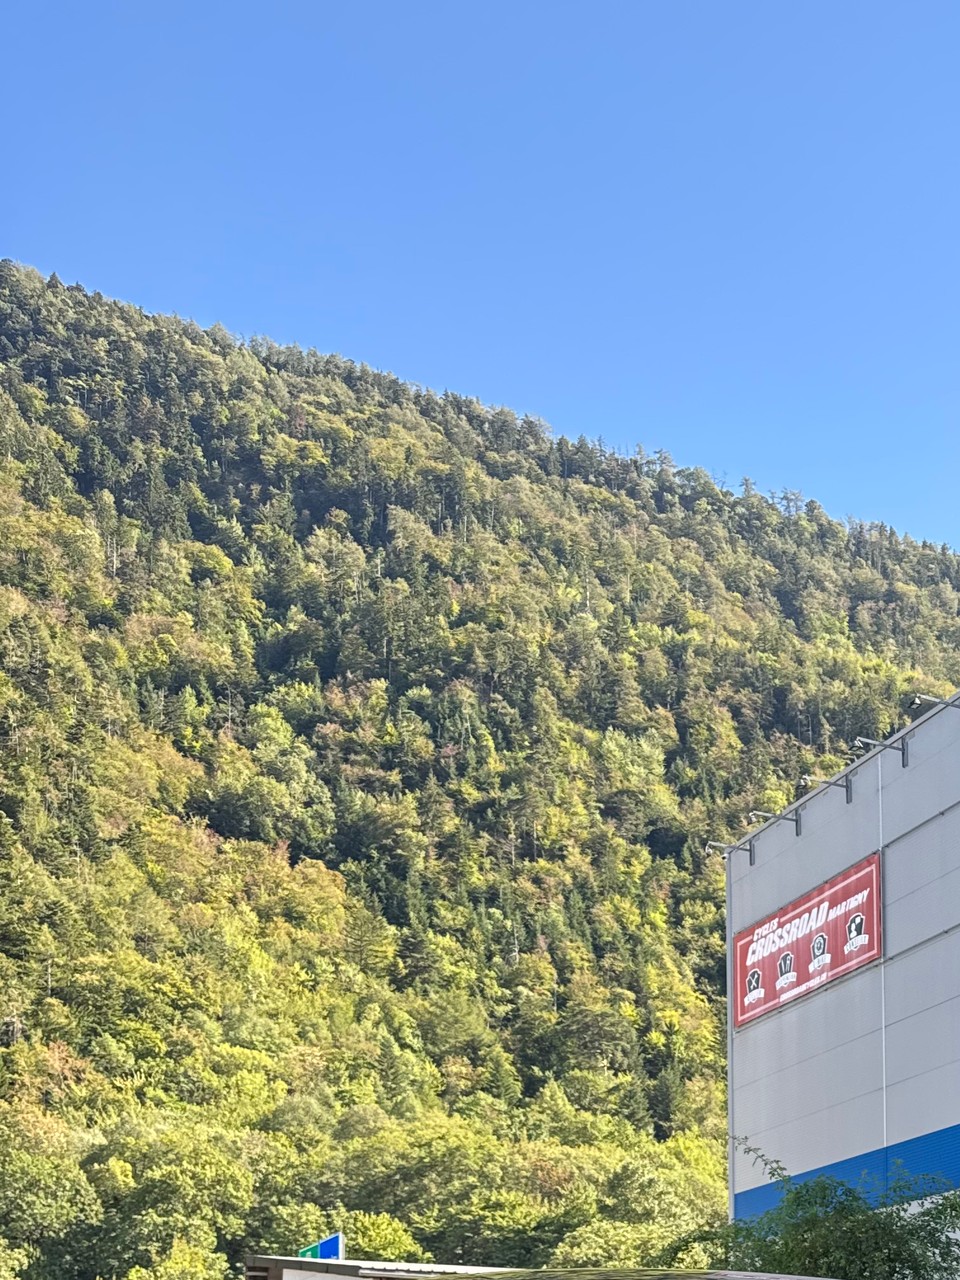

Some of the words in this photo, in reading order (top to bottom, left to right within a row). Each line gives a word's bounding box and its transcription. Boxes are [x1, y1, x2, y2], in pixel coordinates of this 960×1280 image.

[746, 901, 829, 966] CROSSROAD
[827, 888, 870, 922] MARTIGNY
[753, 918, 779, 941] CYCLES
